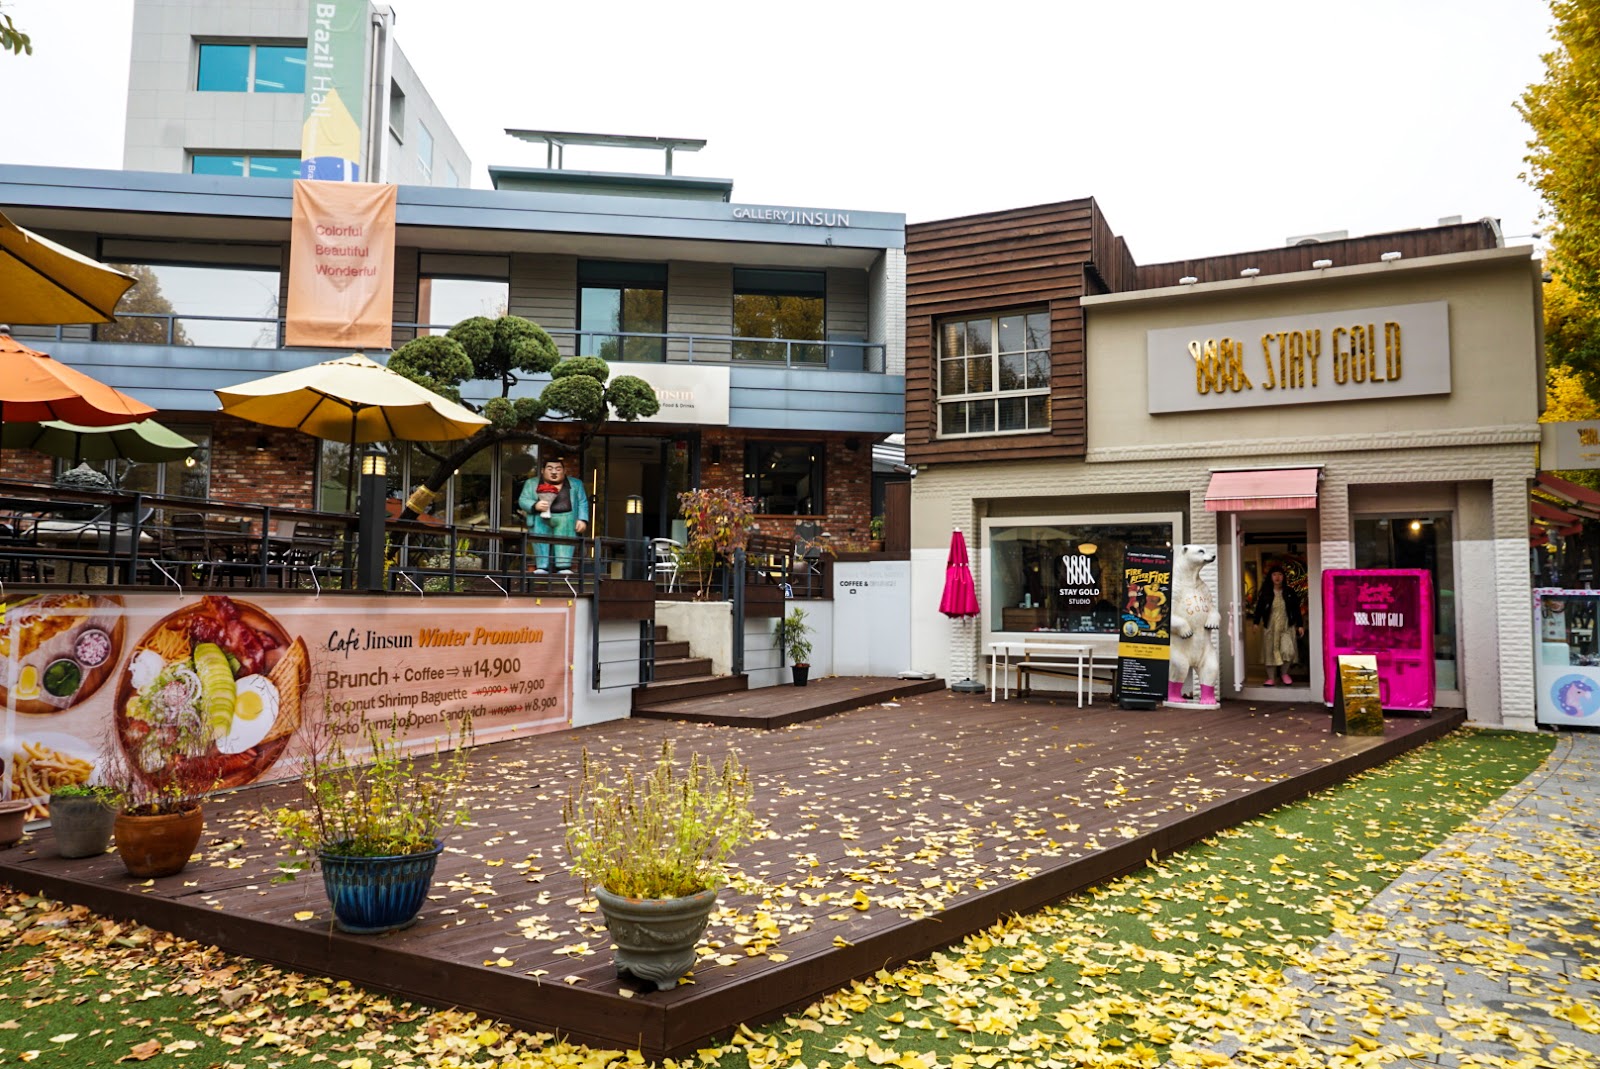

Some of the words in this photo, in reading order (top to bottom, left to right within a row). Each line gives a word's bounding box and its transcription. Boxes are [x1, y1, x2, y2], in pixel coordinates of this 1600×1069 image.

[313, 3, 336, 69] Brazil
[311, 76, 332, 117] Hall
[733, 207, 788, 220] GALLERY
[788, 210, 850, 227] JINSUN
[315, 225, 363, 237] Colorful
[315, 244, 369, 257] Beautiful
[315, 264, 377, 277] Wonderful
[1261, 329, 1321, 390] STAY
[1332, 321, 1402, 385] GOLD
[1148, 571, 1170, 585] FIRE
[1060, 588, 1078, 596] STAY
[1079, 588, 1100, 596] GOLD
[1371, 612, 1387, 626] STAY
[1388, 612, 1404, 627] GOLD
[327, 627, 360, 659] Café
[363, 630, 413, 650] Jinsun
[418, 628, 470, 648] Winter
[472, 626, 544, 645] Promotion
[326, 666, 389, 690] Brunch
[392, 673, 400, 682] +
[404, 666, 445, 682] Coffee
[378, 693, 419, 708] Shrimp
[421, 688, 468, 706] Baguette
[510, 679, 545, 694] ₩7,900
[524, 696, 557, 712] ₩8,900
